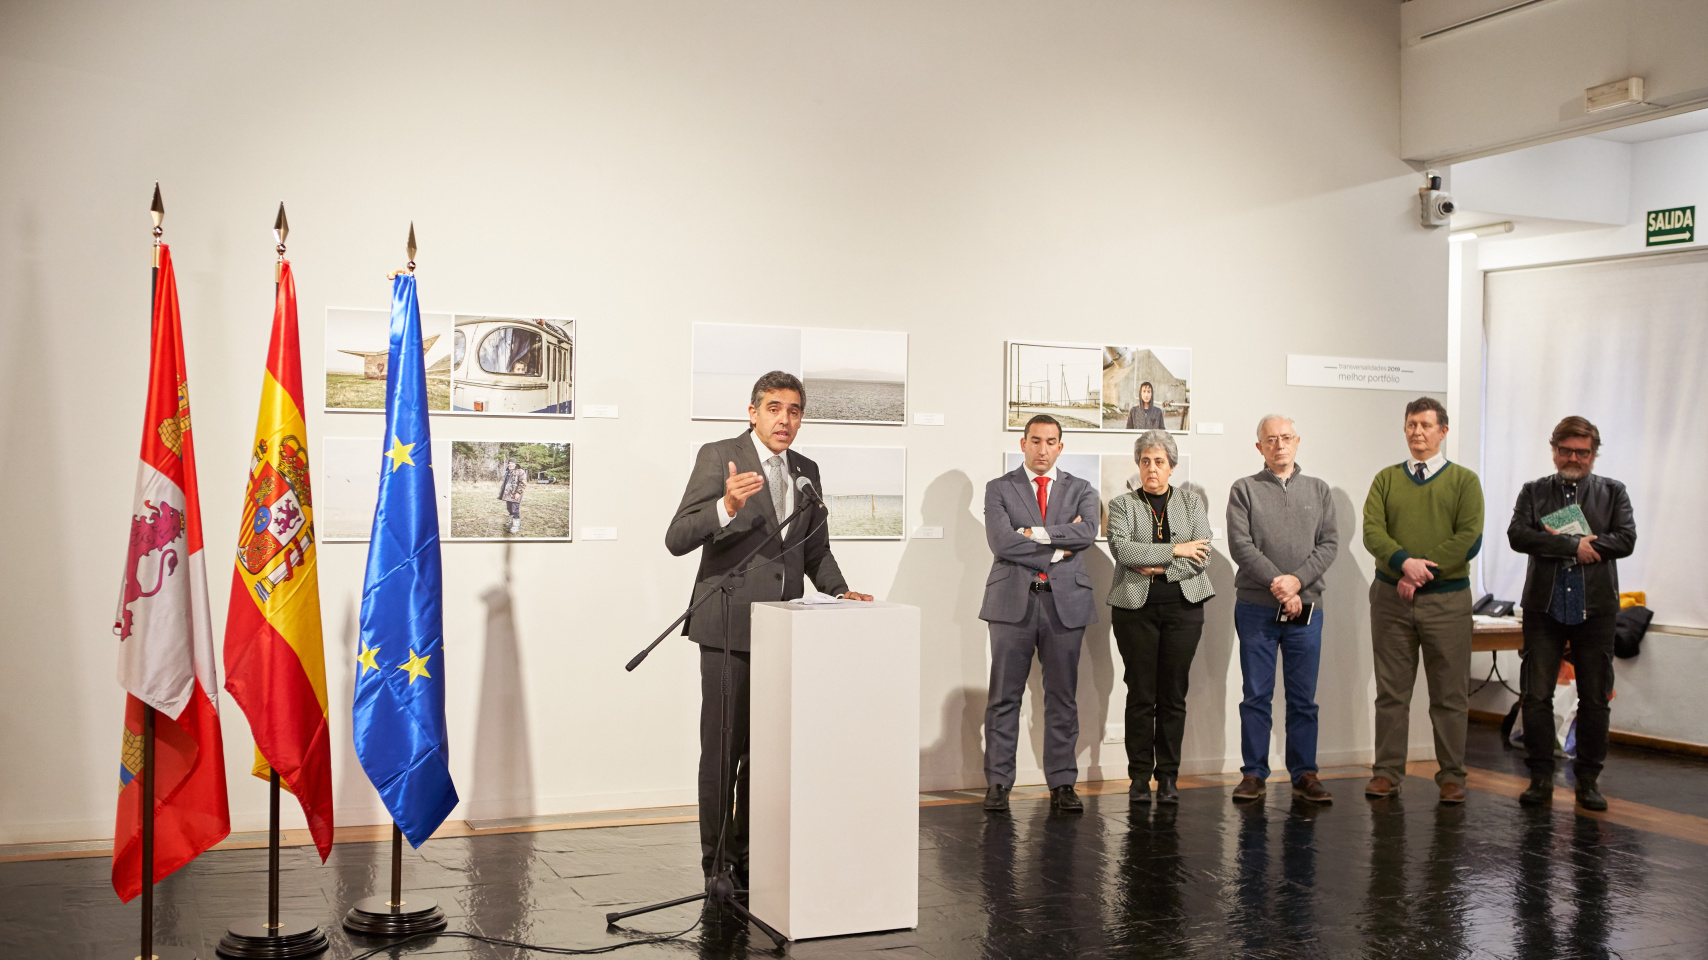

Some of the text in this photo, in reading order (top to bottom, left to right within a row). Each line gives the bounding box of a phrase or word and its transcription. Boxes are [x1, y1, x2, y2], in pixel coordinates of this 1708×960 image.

[1648, 209, 1693, 231] SALIDA
[1338, 363, 1387, 371] transversalidades
[1338, 373, 1400, 383] melhor portfólio
